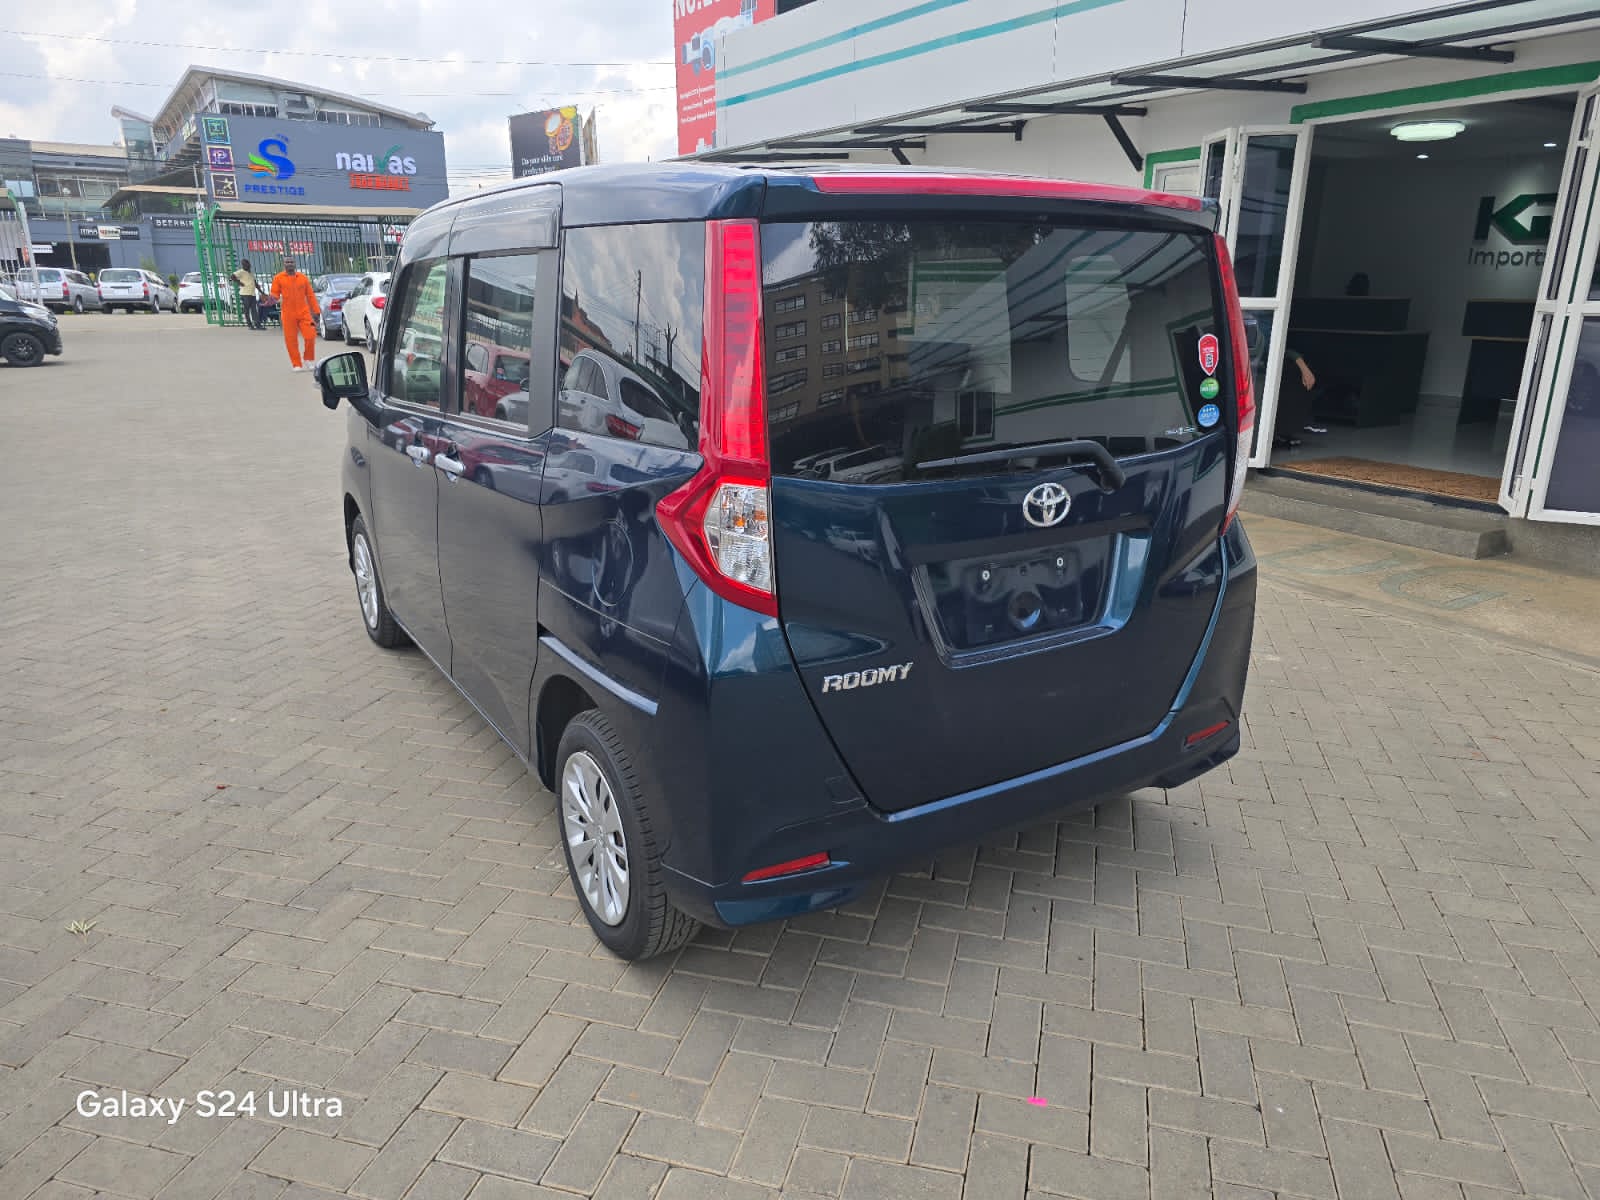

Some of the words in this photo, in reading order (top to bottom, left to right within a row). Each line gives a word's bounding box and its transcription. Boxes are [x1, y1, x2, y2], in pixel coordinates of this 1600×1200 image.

[244, 184, 305, 196] PRESTIGE
[1467, 247, 1545, 270] Import
[822, 661, 914, 693] ROOMY
